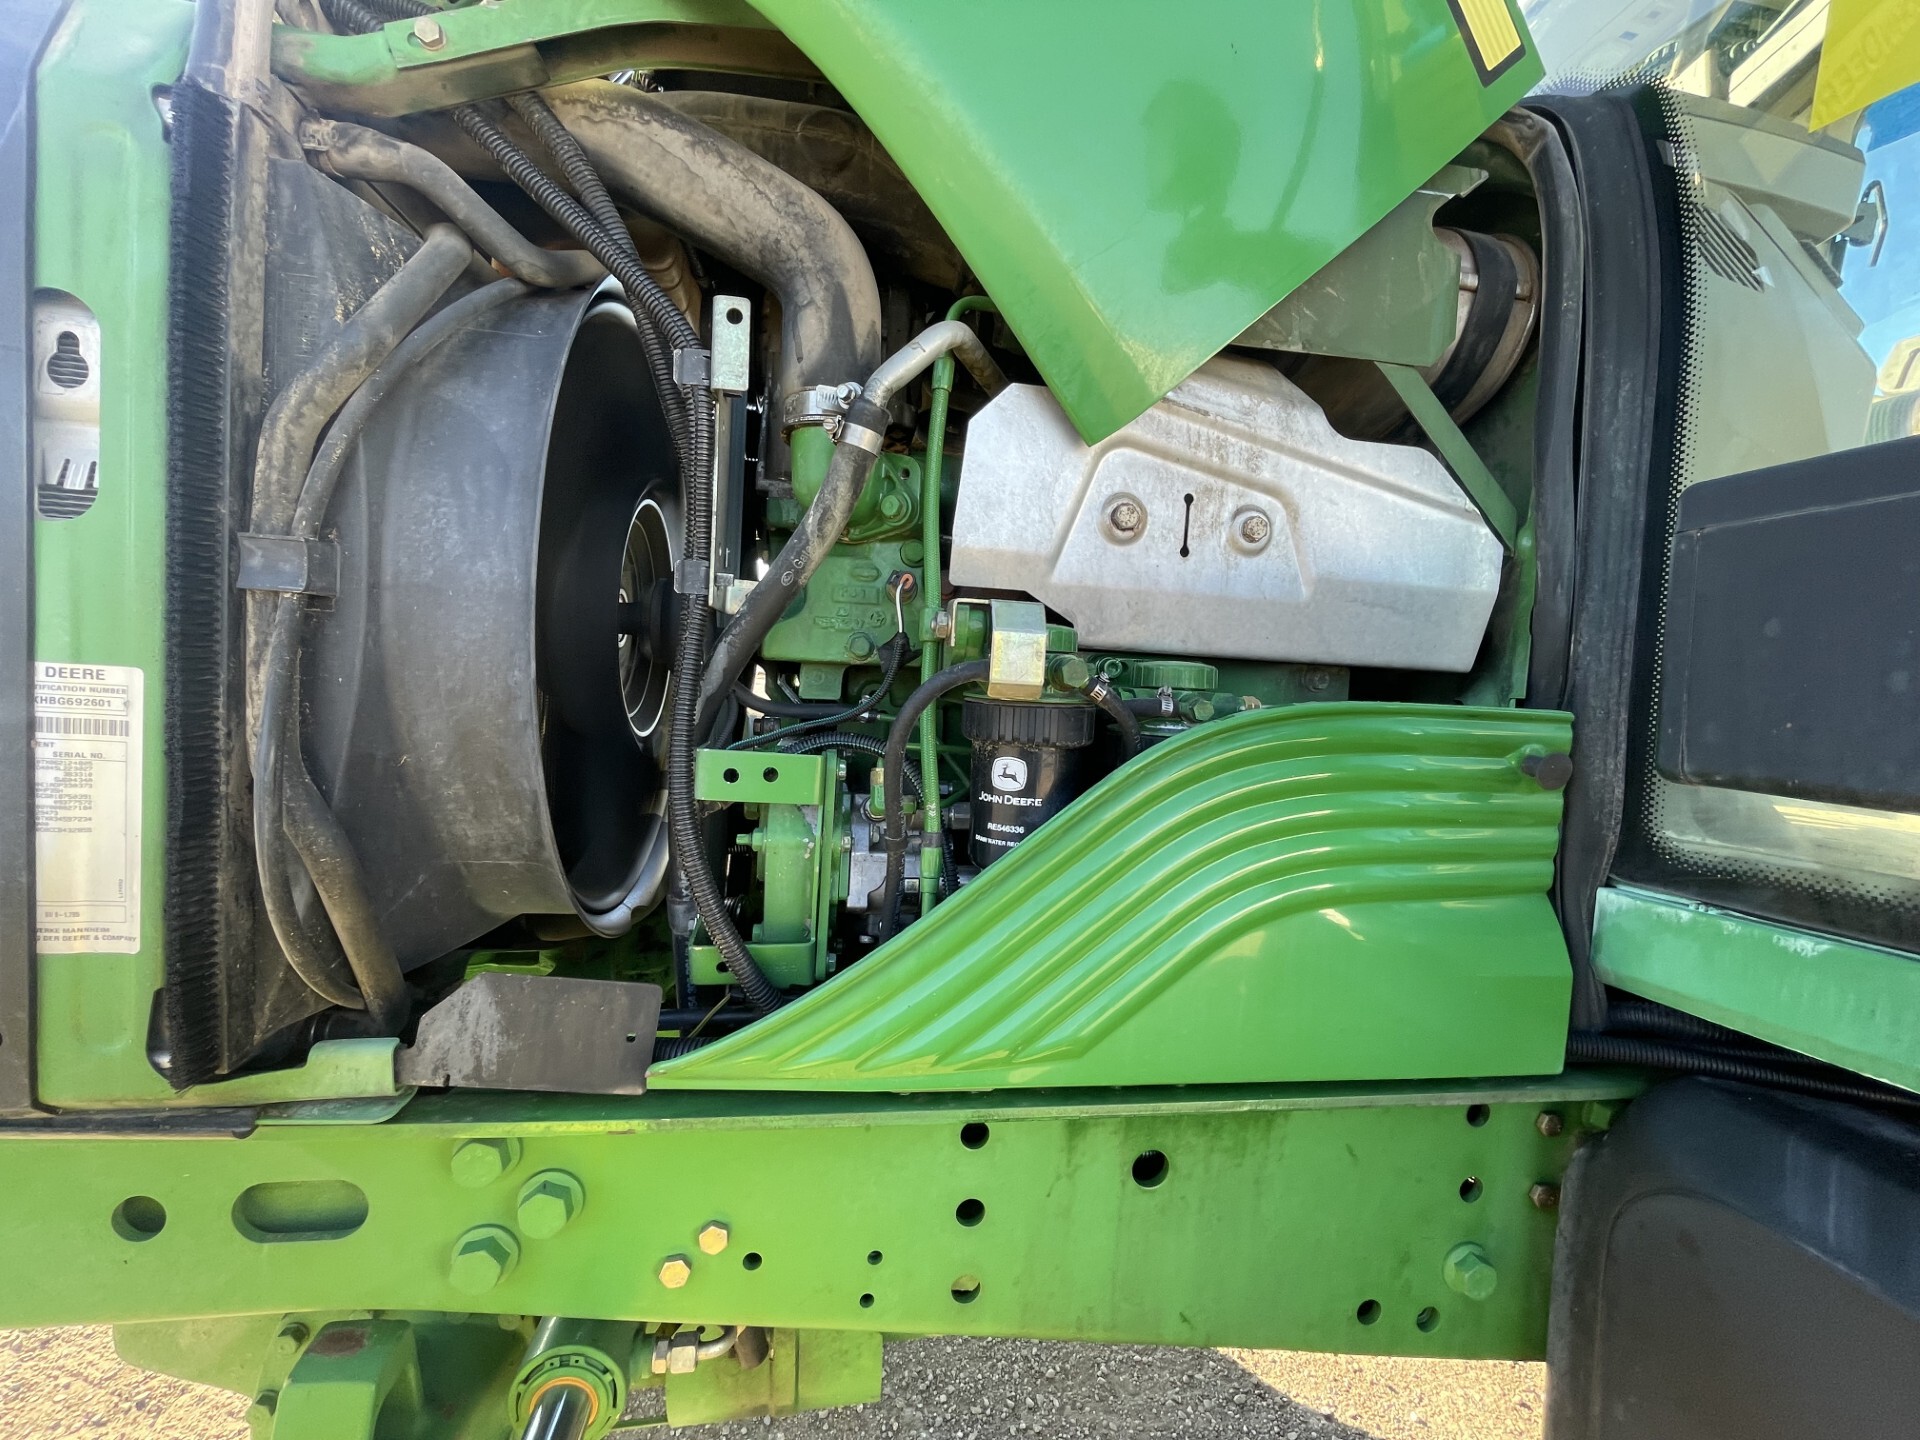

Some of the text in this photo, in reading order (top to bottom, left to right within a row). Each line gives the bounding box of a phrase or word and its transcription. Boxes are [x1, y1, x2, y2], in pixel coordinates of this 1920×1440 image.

[45, 666, 106, 680] DEERE
[89, 686, 127, 695] NUMBER
[52, 751, 87, 759] SERIAL
[979, 791, 1043, 806] JOHN DEERE
[987, 822, 1024, 833] RE546336
[102, 934, 137, 942] COMPANY
